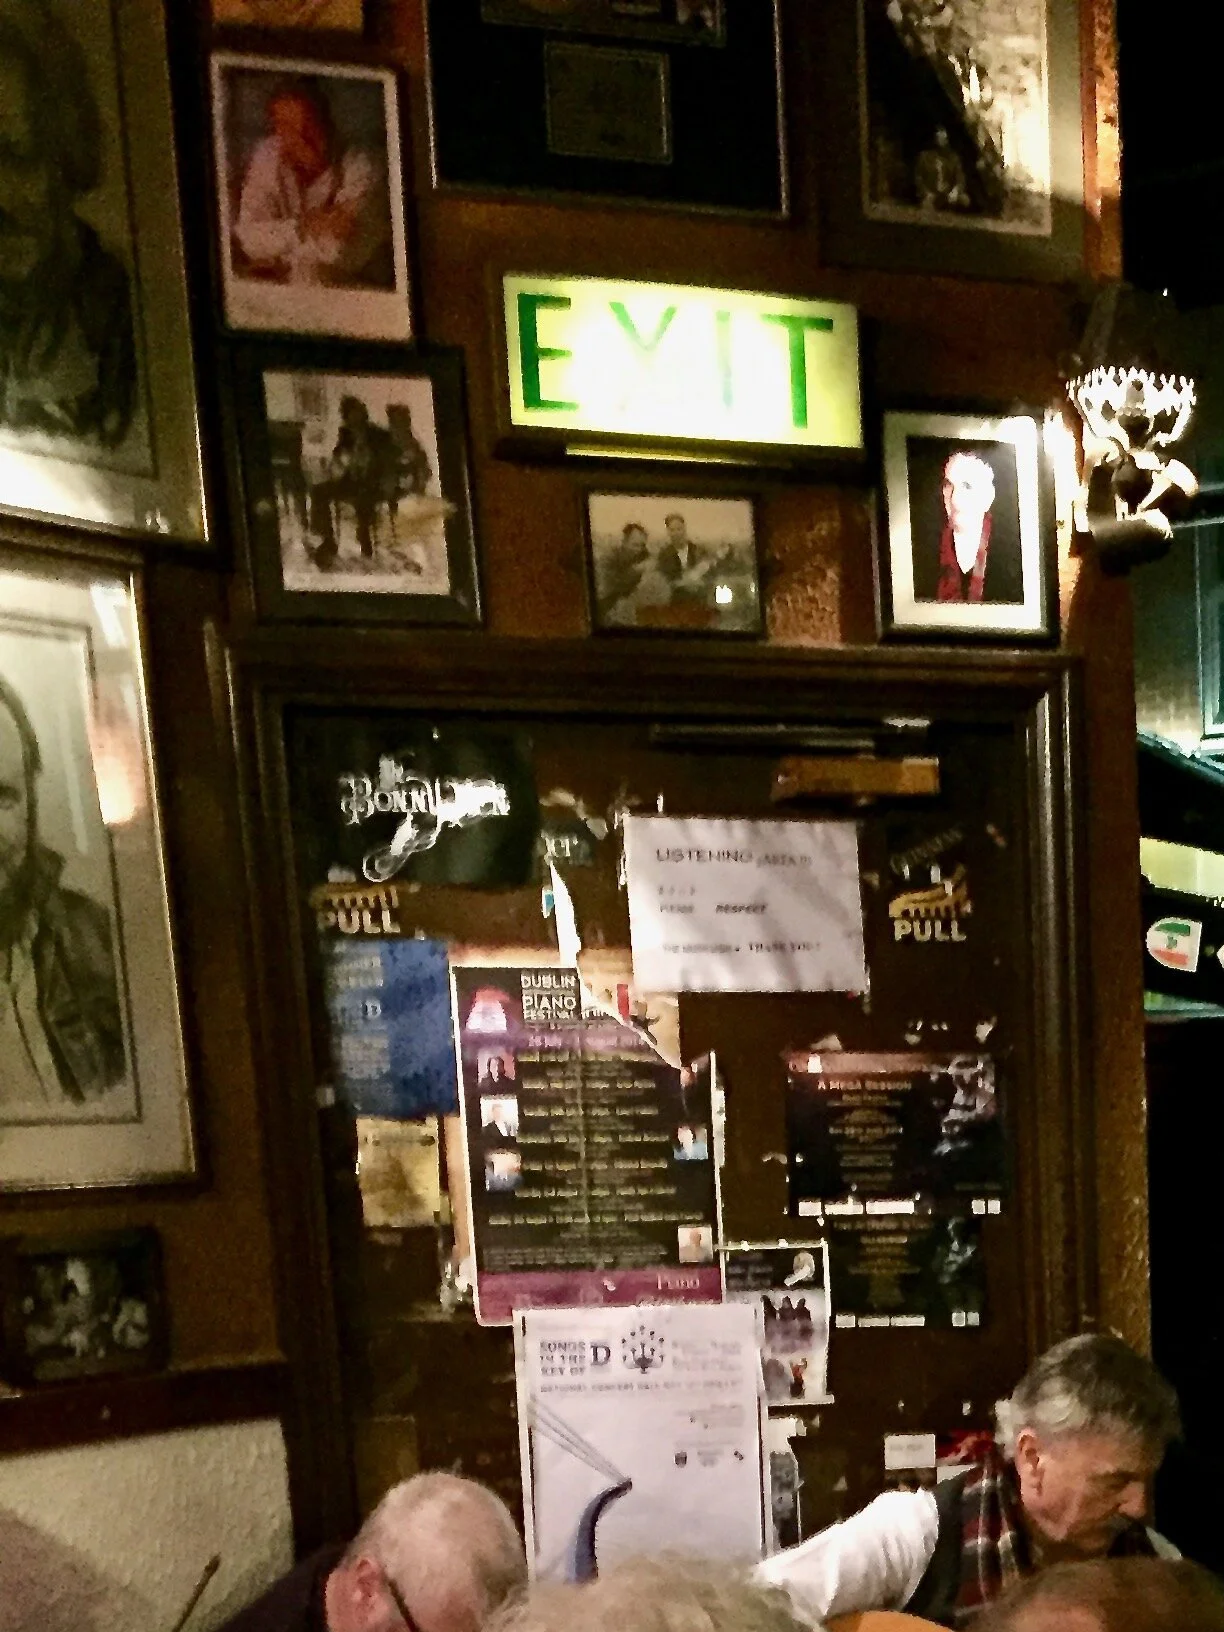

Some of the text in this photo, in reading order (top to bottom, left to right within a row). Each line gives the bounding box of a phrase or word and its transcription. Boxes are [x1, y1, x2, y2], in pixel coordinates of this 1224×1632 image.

[517, 293, 834, 429] EXIT
[318, 909, 400, 933] PULL
[894, 919, 967, 941] PULL
[521, 975, 576, 988] DUBLIN
[524, 994, 577, 1010] PIANO
[590, 1344, 611, 1367] D
